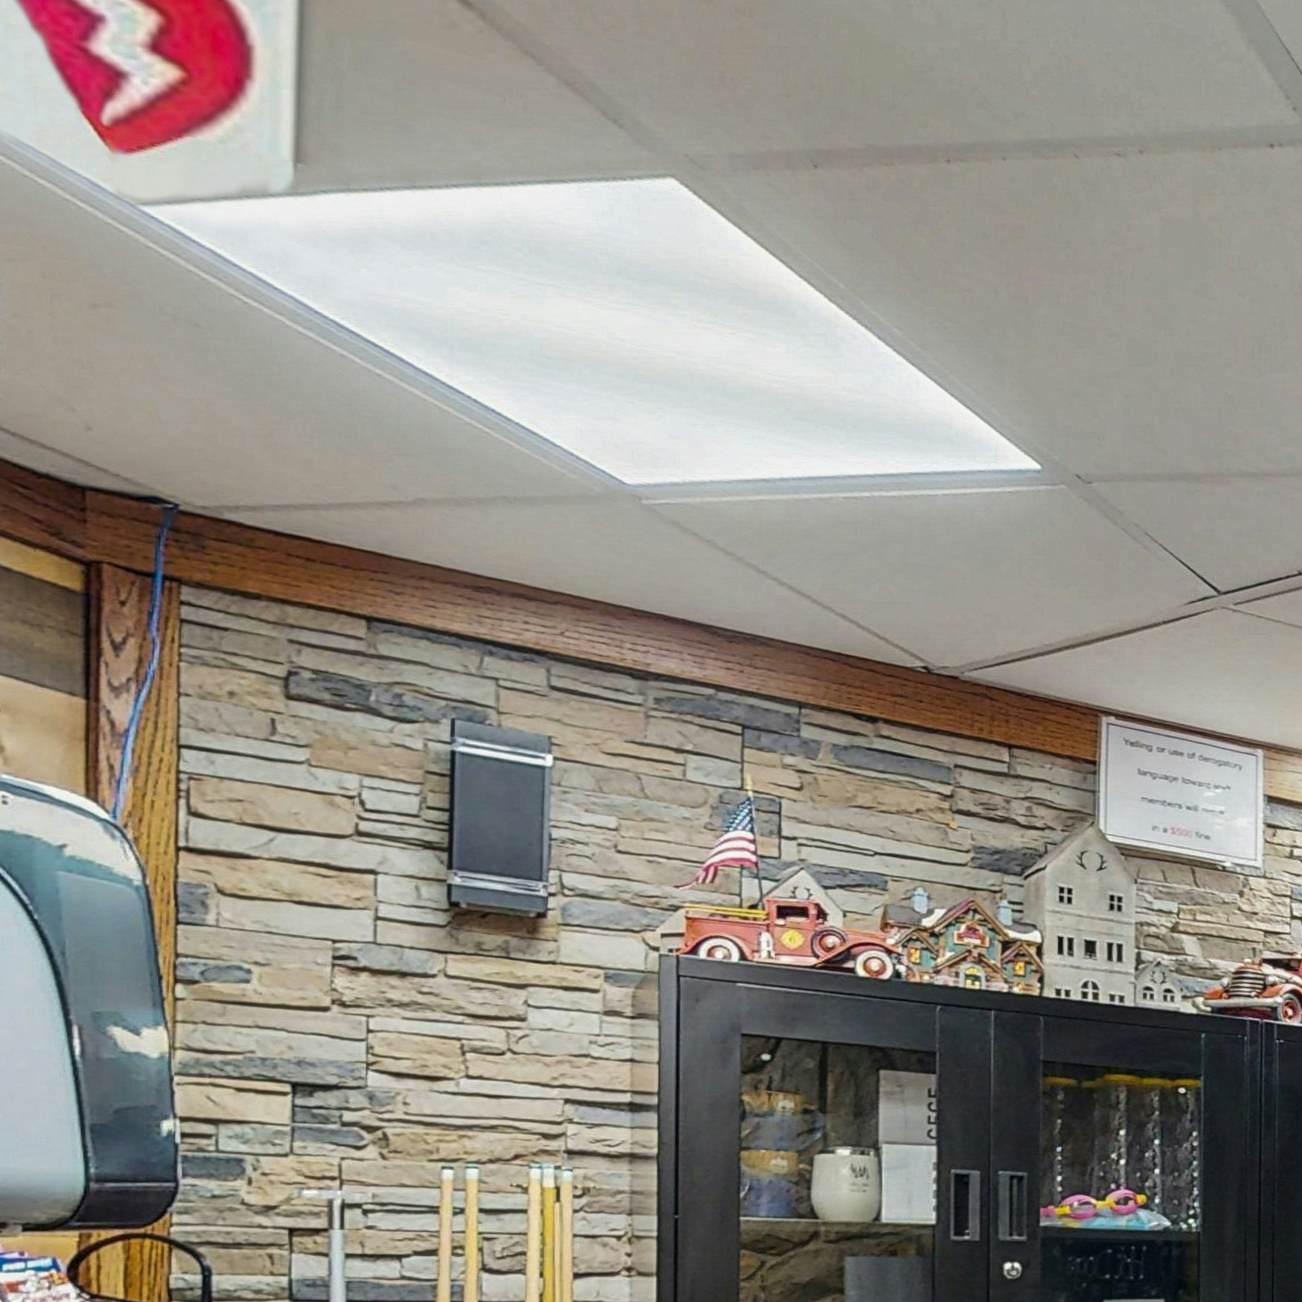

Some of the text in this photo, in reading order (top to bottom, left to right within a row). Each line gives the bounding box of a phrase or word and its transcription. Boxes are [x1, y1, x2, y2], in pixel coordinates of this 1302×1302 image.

[1123, 737, 1153, 753] Yelling
[1198, 755, 1242, 771] derogatory
[1137, 768, 1179, 783] language
